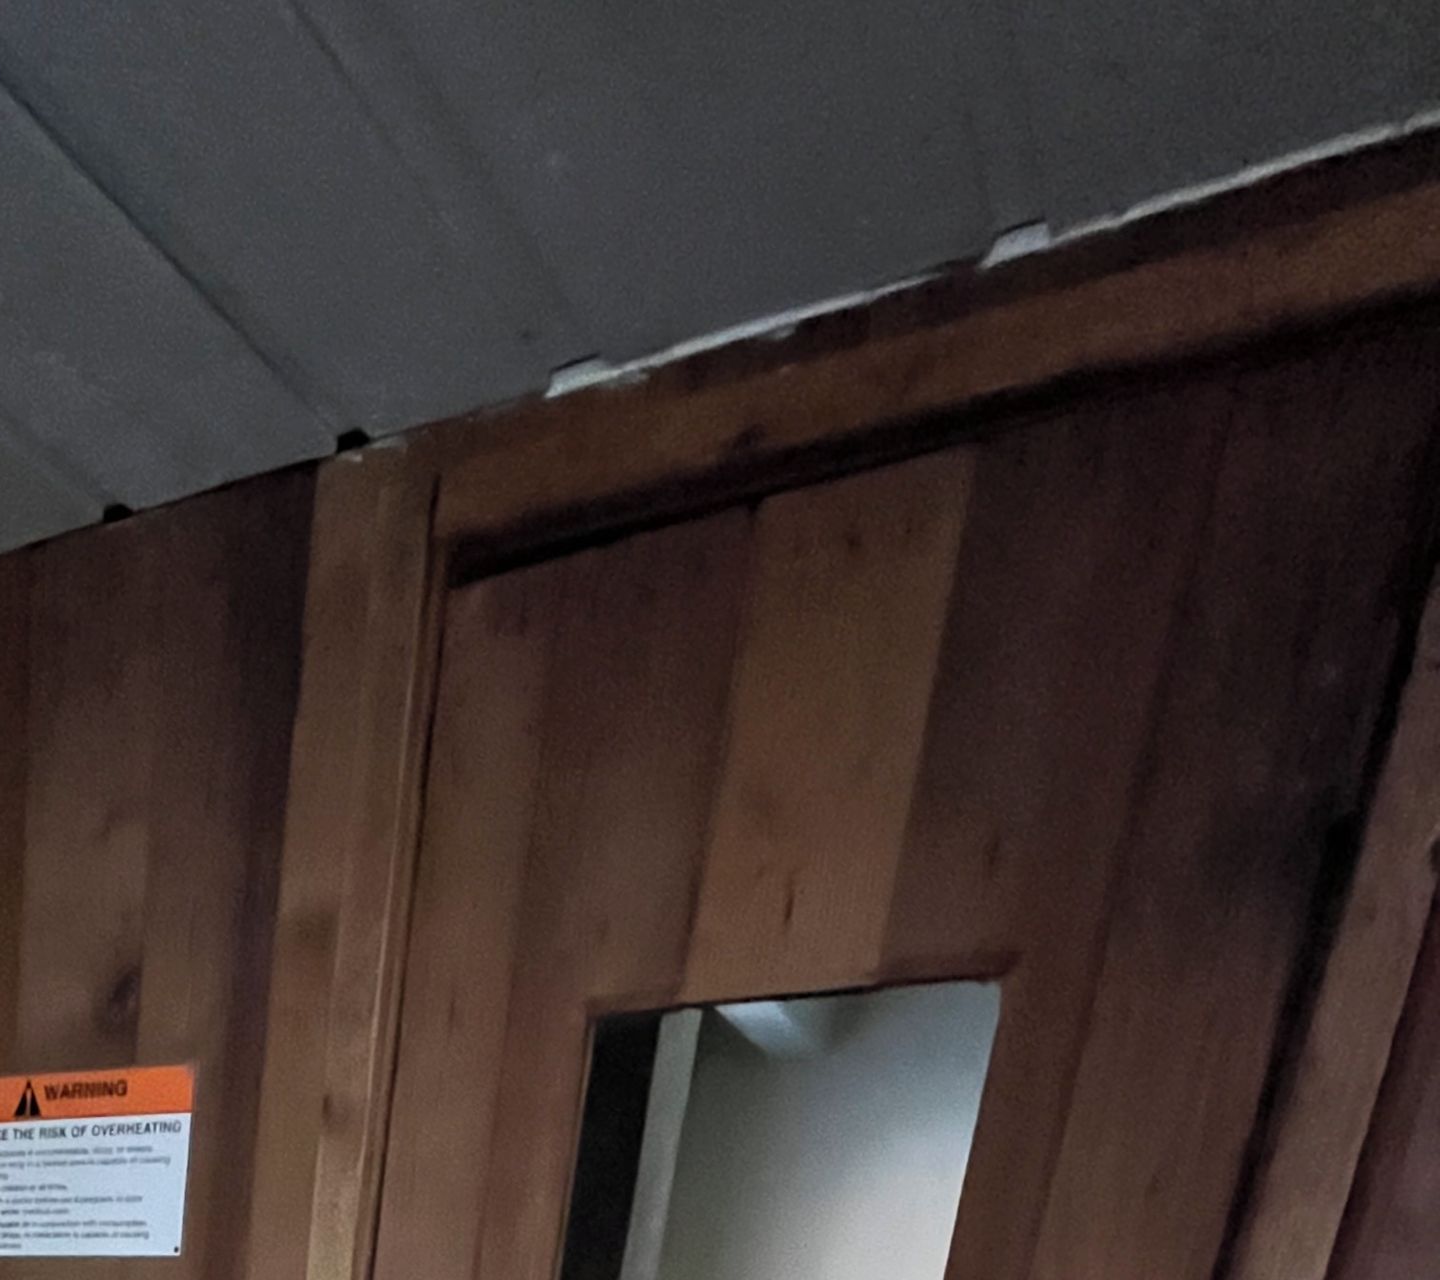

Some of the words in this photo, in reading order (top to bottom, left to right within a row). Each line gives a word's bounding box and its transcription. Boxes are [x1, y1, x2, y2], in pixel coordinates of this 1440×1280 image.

[44, 1079, 128, 1101] WARNING
[13, 1127, 34, 1141] THE
[39, 1125, 66, 1139] RISK
[71, 1124, 87, 1137] OF
[91, 1119, 182, 1136] OVERHEATING
